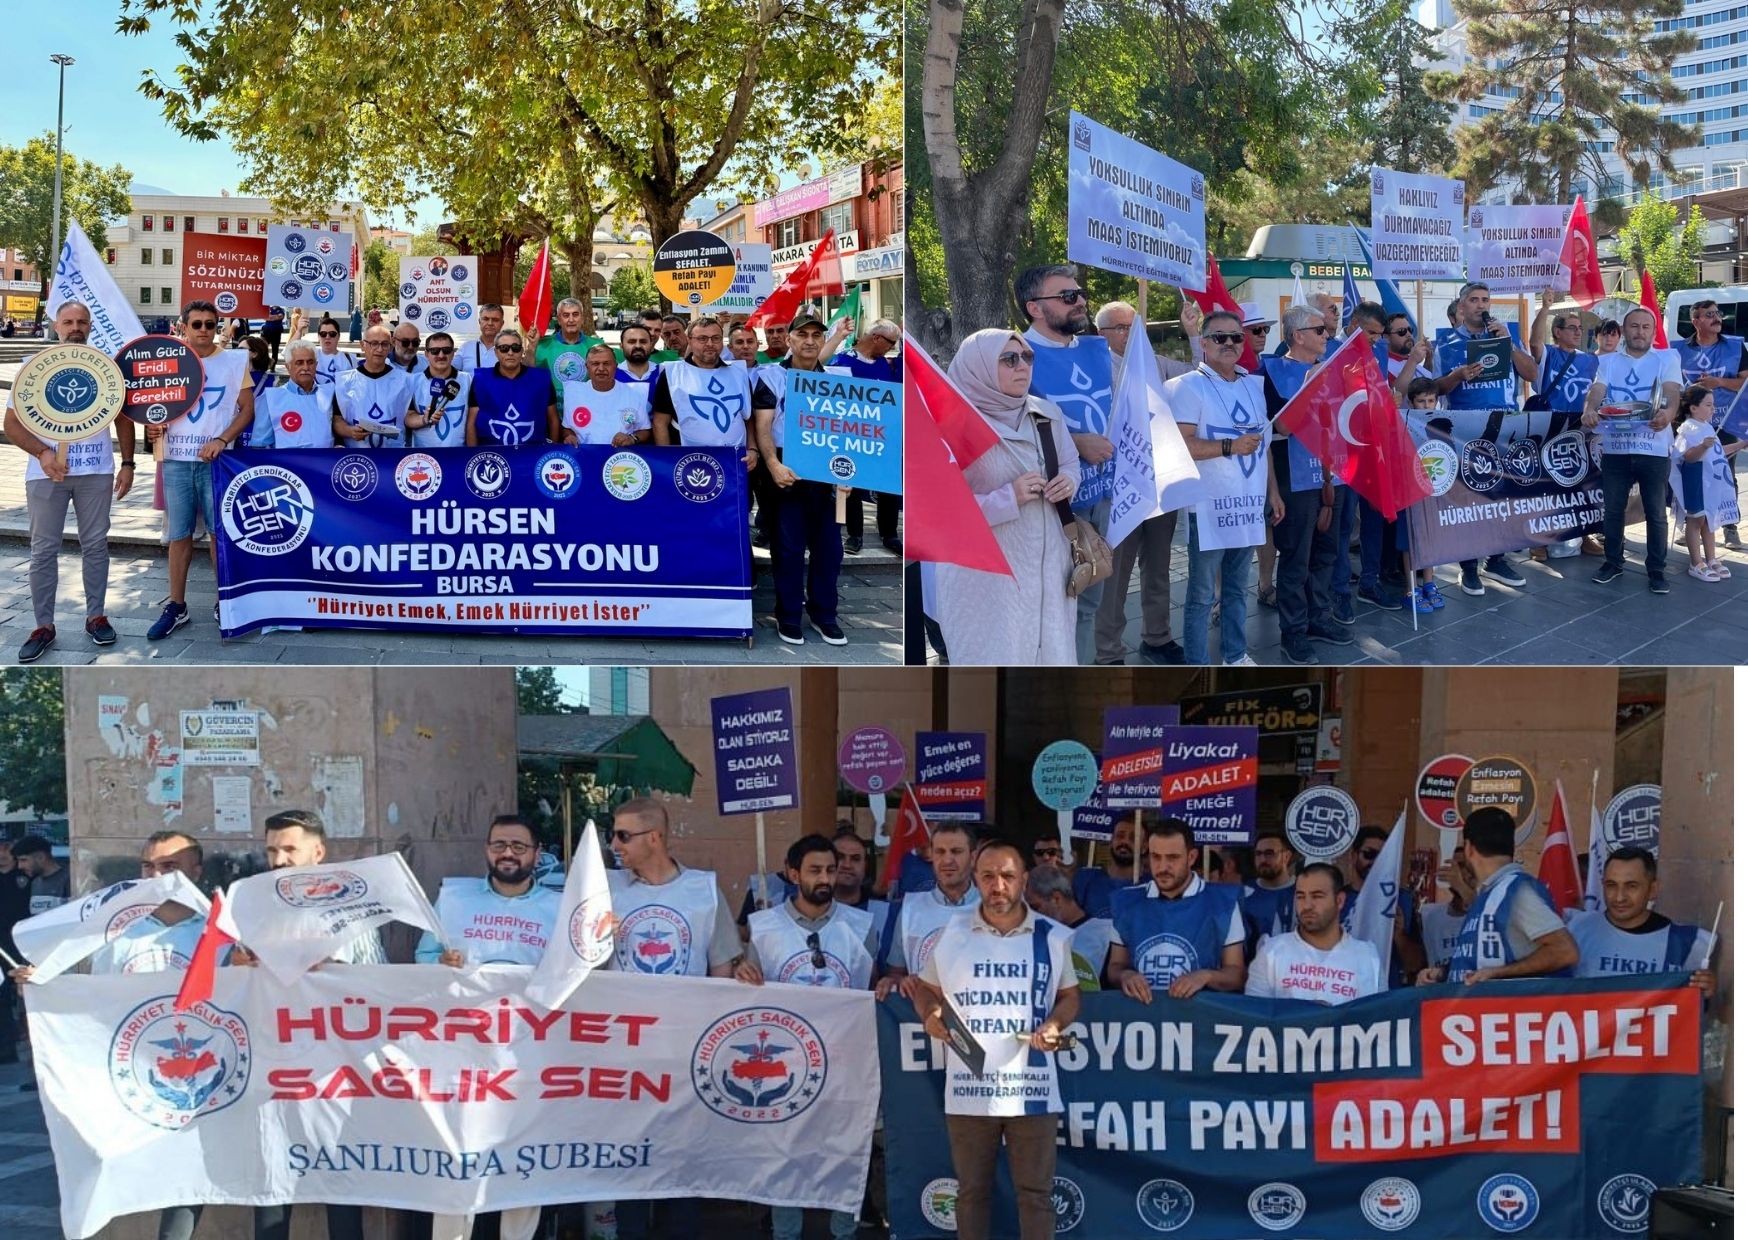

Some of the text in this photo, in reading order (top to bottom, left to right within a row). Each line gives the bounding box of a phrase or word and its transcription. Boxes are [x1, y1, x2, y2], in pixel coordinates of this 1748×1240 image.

[1089, 156, 1191, 213] YOKSULLUK SINIRIN
[1399, 188, 1438, 208] HAKLIYIZ
[1122, 200, 1165, 230] ALTINDA
[1384, 214, 1452, 236] DURMAYACAĞIZ
[1482, 227, 1560, 240] YOKSULLUK SINIRIN
[1088, 217, 1192, 265] MAAŞ İSTEMİYORUZ
[197, 250, 259, 262] BİR MİKTAR
[660, 248, 698, 260] Enflasyon
[700, 246, 728, 256] Zammı
[772, 246, 804, 264] NKARA
[1376, 242, 1460, 264] VAZGEÇMEYECEĞİZ!
[1505, 246, 1538, 259] ALTINDA
[188, 264, 264, 280] SÖZÜNÜZÜ
[672, 270, 716, 280] Refah Payı
[856, 258, 880, 273] FOTO
[1102, 256, 1144, 273] HÜRRİYETÇİ
[1170, 273, 1182, 282] SEN
[1310, 266, 1344, 276] BEBE
[1481, 264, 1560, 280] MAAŞ İSTEMİYORUZ
[190, 281, 262, 292] TUTARMISINIZ
[678, 281, 710, 291] ADALET!
[124, 346, 186, 360] Alım Gücü
[25, 348, 118, 392] EK DERS ÜCRETLERİ
[138, 362, 172, 374] Eridi,
[124, 376, 189, 389] Refah payı
[794, 373, 896, 406] İNSANCA
[806, 396, 880, 421] YAŞAM
[25, 405, 109, 433] ARTIRILMALIDIR
[799, 410, 886, 440] İSTEMEK
[802, 431, 885, 456] SUÇ MU?
[1551, 456, 1581, 470] SEN
[254, 468, 302, 490] SENDİKALAR
[1438, 488, 1604, 527] HÜRRİYETÇİ SENDİKALAR KO
[243, 504, 299, 538] SEN
[412, 500, 555, 535] HÜRSEN
[1529, 508, 1605, 534] KAYSERİ ŞUBE
[245, 526, 307, 553] KONFEDERASYONU
[312, 543, 659, 573] KONFEDARASYONU
[437, 575, 514, 595] BURSA
[398, 600, 452, 622] Emek,
[456, 603, 504, 621] Emek
[509, 602, 588, 623] Hürriyet
[721, 710, 783, 730] HAKKIMIZ
[718, 730, 790, 749] OLAN İSTİYORUZ
[1110, 726, 1126, 738] Alın
[924, 740, 972, 757] Emek en
[728, 754, 783, 771] SADAKA
[920, 752, 981, 782] yüce değerse
[736, 772, 778, 791] DEĞİL!
[1471, 768, 1522, 781] Enflasyon
[920, 786, 981, 799] neden açız?
[1108, 784, 1162, 796] ile terliyor
[1467, 793, 1523, 803] Refah Payı
[1186, 794, 1234, 810] EMEĞE
[1077, 813, 1112, 825] nerde
[1300, 822, 1342, 840] SEN
[474, 913, 543, 934] HÜRRİYET
[464, 927, 547, 949] SAĞLIK SEN
[974, 959, 1028, 978] FİKRİ
[1600, 954, 1657, 972] FİKRİ
[1290, 964, 1354, 982] HÜRRİYET
[954, 987, 1027, 1006] VİCDANI
[1282, 977, 1358, 997] SAĞLIK SEN
[277, 998, 660, 1046] HÜRRİYET
[116, 1003, 247, 1062] HÜRRİYET SEN
[699, 1012, 821, 1067] HÜRRİYET SAĞLIK SEN
[1213, 1018, 1411, 1073] ZAMMI
[1441, 1005, 1678, 1066] SEFALET
[268, 1058, 671, 1103] SAĞLIK SEN
[954, 1086, 1050, 1097] KONFEDERASYONU
[728, 1106, 780, 1118] 2022
[1190, 1100, 1306, 1151] PAYI
[1330, 1089, 1562, 1150] ADALET!
[289, 1138, 652, 1180] ŞANLIURFA ŞUBESİ
